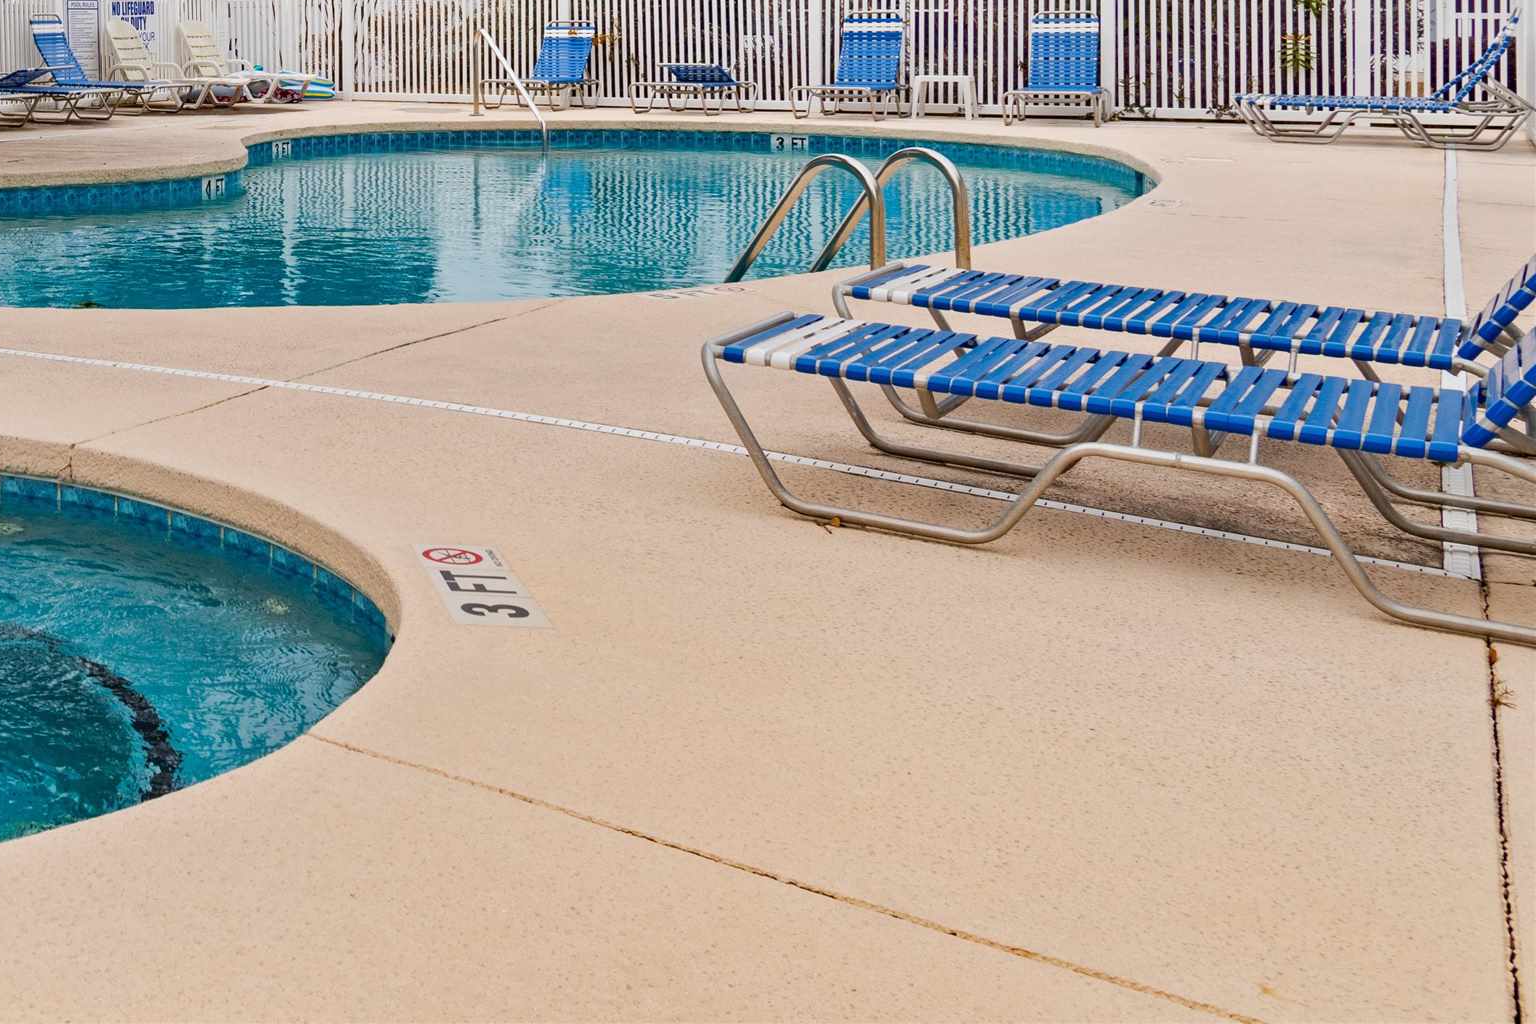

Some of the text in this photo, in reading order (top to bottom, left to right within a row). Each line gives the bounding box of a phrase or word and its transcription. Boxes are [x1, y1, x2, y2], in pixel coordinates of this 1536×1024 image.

[111, 1, 154, 16] NO LIFEGUARD
[776, 137, 806, 152] 3 FT
[439, 570, 530, 618] 3 FT
